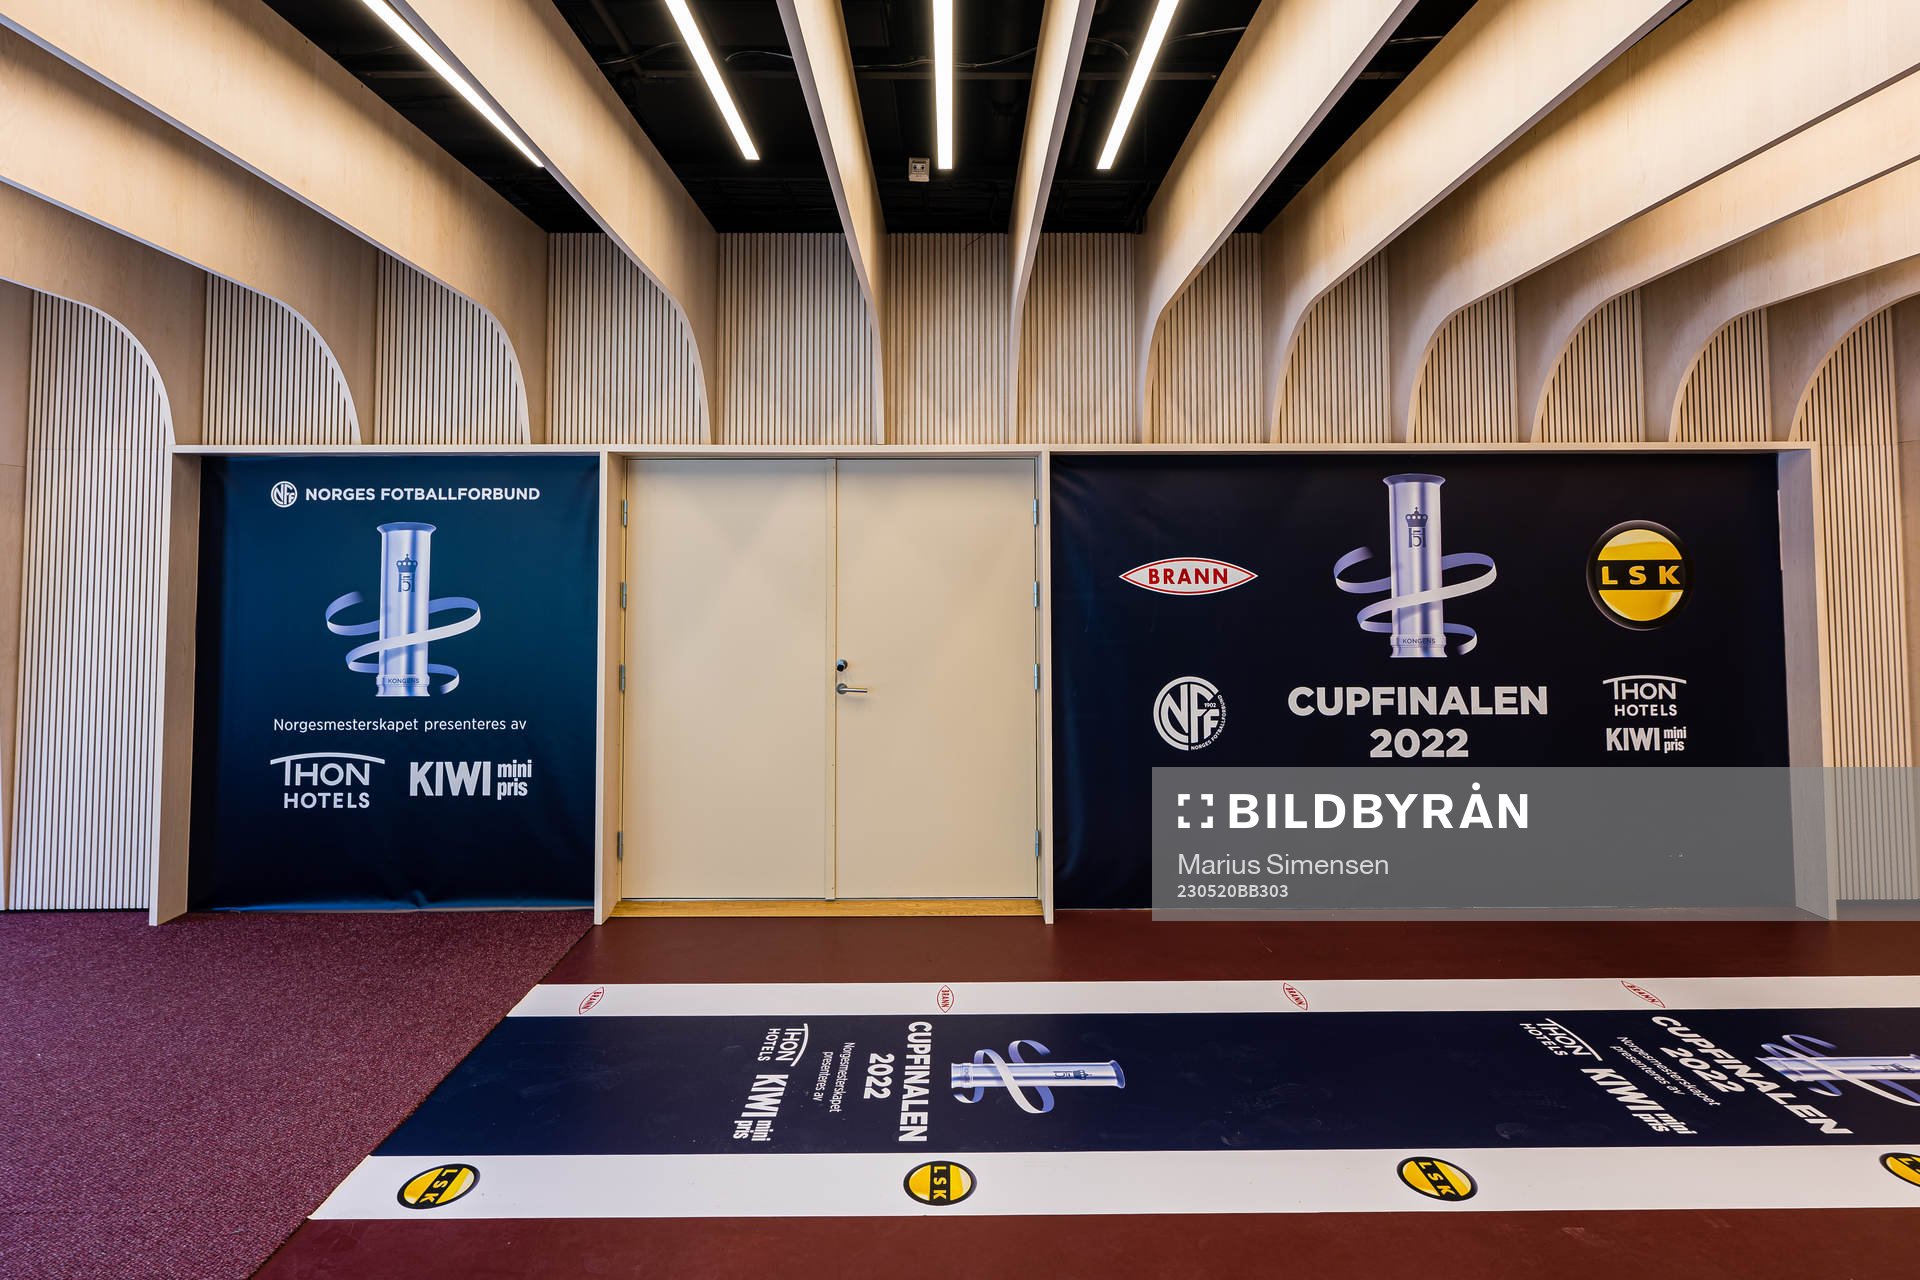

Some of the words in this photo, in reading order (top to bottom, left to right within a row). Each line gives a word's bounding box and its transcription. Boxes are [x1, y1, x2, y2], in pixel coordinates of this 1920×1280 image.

[305, 487, 375, 501] NORGES
[380, 487, 541, 501] FOTBALLFORBUND
[1148, 567, 1228, 585] BRANN
[1287, 686, 1548, 716] CUPFINALEN
[1602, 674, 1687, 700] THON
[273, 718, 418, 733] Norgesmesterskapet
[424, 718, 506, 732] presenteres
[510, 719, 527, 730] av
[1614, 704, 1678, 717] HOTELS
[1369, 728, 1469, 759] 2022
[1606, 727, 1661, 751] KIWI
[1663, 726, 1687, 739] mini
[1663, 738, 1685, 754] pris
[270, 752, 385, 786] THON
[409, 761, 491, 797] KIWI
[497, 759, 532, 778] mini
[283, 792, 370, 809] HOTELS
[497, 778, 528, 801] pris
[757, 1028, 781, 1062] HOTELS
[775, 1023, 809, 1067] THON
[1519, 1023, 1569, 1056] HOTELS
[1536, 1018, 1603, 1061] THON
[815, 1051, 834, 1092] presenteres
[829, 1042, 855, 1113] Norgesmesterskapet
[863, 1053, 895, 1099] 2022
[898, 1021, 933, 1142] CUPFINALEN
[1609, 1046, 1672, 1085] presenteres
[1666, 1085, 1686, 1096] av
[1616, 1036, 1721, 1106] Norgesmesterskapet
[1651, 1016, 1855, 1135] CUPFINALEN
[1660, 1047, 1746, 1093] 2022
[740, 1074, 789, 1117] KIWI
[812, 1091, 825, 1101] av
[1580, 1068, 1665, 1111] KIWI
[1654, 1113, 1698, 1135] mini
[733, 1119, 753, 1140] pris
[751, 1119, 774, 1142] mini
[1631, 1113, 1670, 1133] pris
[419, 1169, 458, 1203] LSK
[933, 1166, 947, 1200] LSK
[1418, 1161, 1456, 1195] LSK
